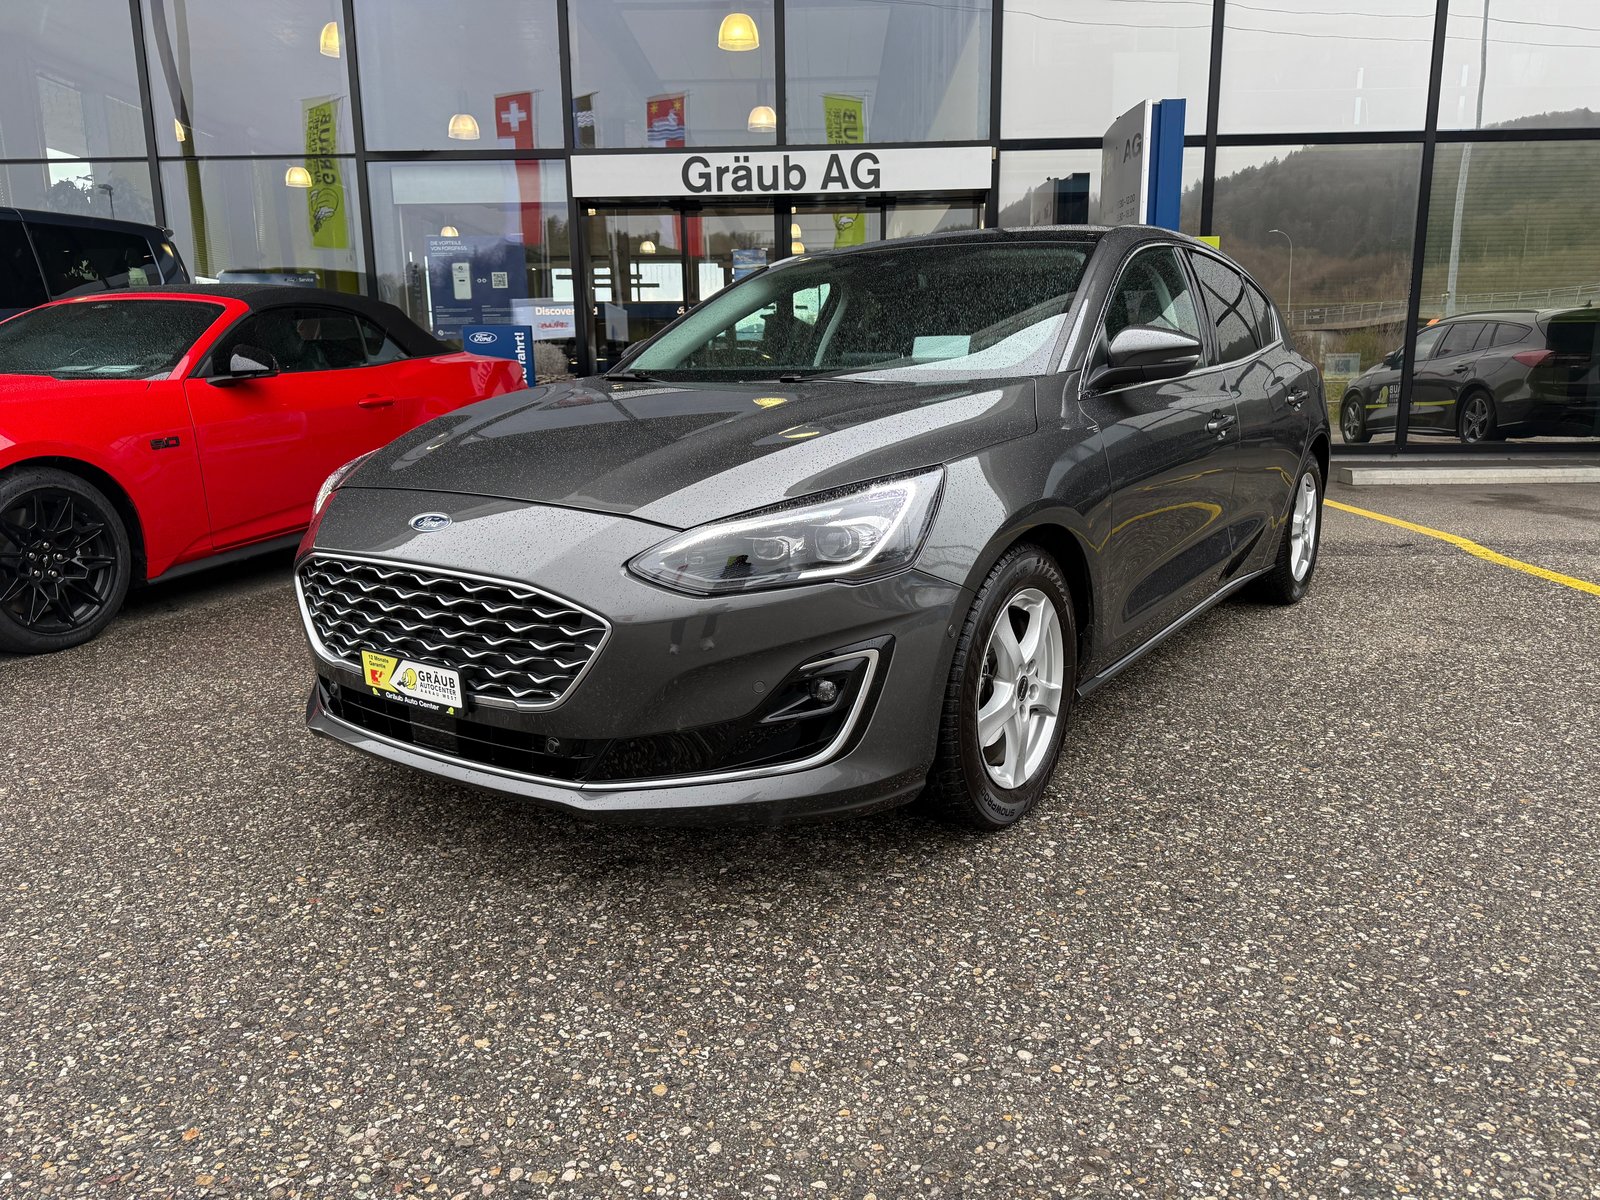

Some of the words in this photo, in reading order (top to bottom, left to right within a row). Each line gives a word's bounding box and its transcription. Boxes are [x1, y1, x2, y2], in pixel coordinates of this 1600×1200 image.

[1123, 133, 1142, 163] AG
[681, 155, 807, 193] Gräub
[820, 152, 881, 190] AG
[472, 332, 494, 342] Ford
[414, 515, 450, 530] Ford
[418, 670, 456, 688] GRÄUB
[419, 683, 457, 696] AUTOCENTER
[404, 697, 418, 706] Auto
[419, 700, 440, 710] Center
[980, 786, 1016, 817] SNOWPROO
